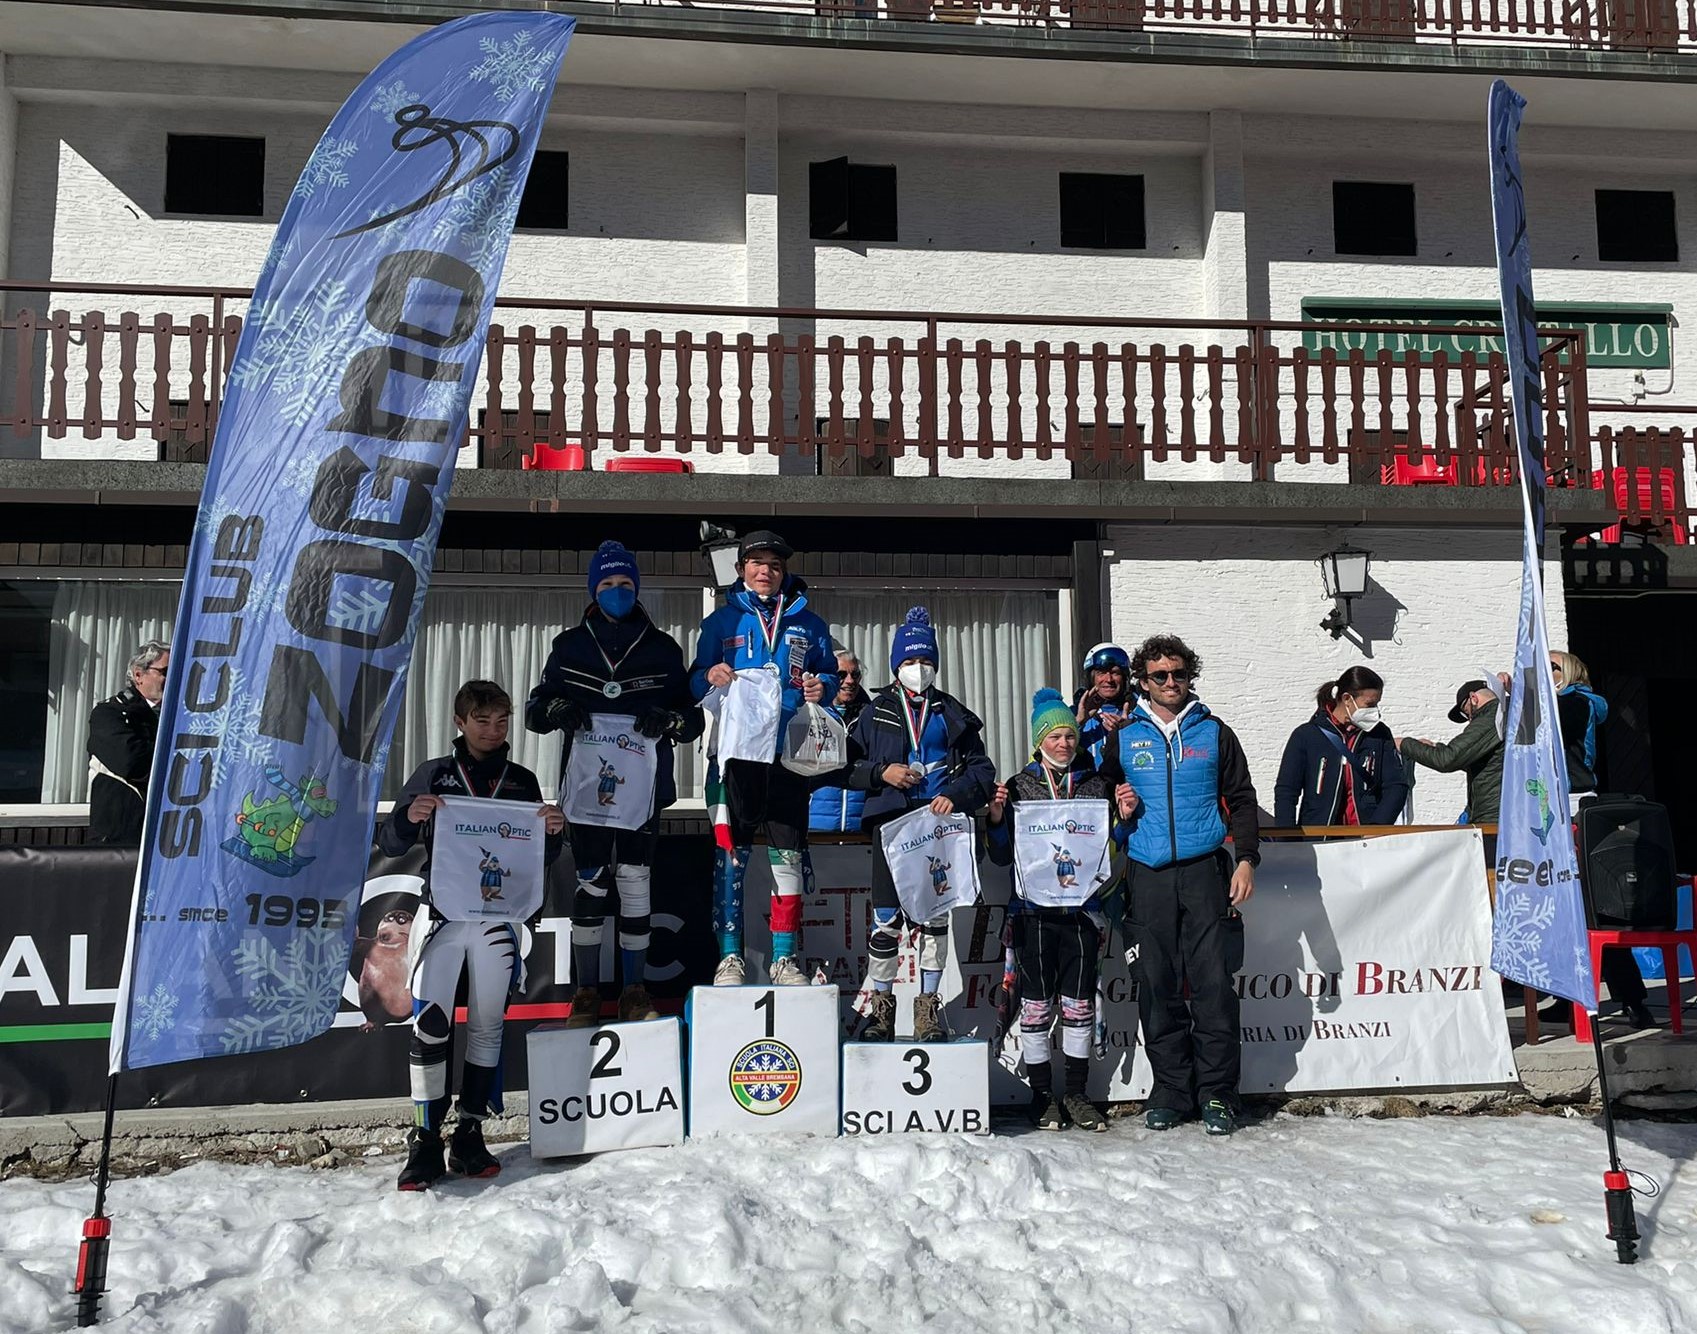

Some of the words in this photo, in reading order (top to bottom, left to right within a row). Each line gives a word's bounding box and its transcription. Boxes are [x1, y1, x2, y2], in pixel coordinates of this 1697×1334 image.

[1313, 318, 1441, 353] HOTEL
[185, 514, 264, 713] CLUB
[159, 733, 219, 859] SCI
[245, 893, 345, 929] 1995
[1305, 972, 1342, 998] DI
[1354, 961, 1484, 996] BRANZI
[754, 990, 775, 1037] 1
[1282, 1025, 1306, 1042] DI
[1313, 1019, 1393, 1040] BRANZI
[589, 1030, 622, 1079] 2
[736, 1046, 758, 1069] SCUOLA
[760, 1044, 787, 1057] ITALIANA
[786, 1057, 795, 1069] SCI
[902, 1048, 932, 1096] 3
[538, 1086, 679, 1125] SCUOLA
[843, 1110, 893, 1135] SCI
